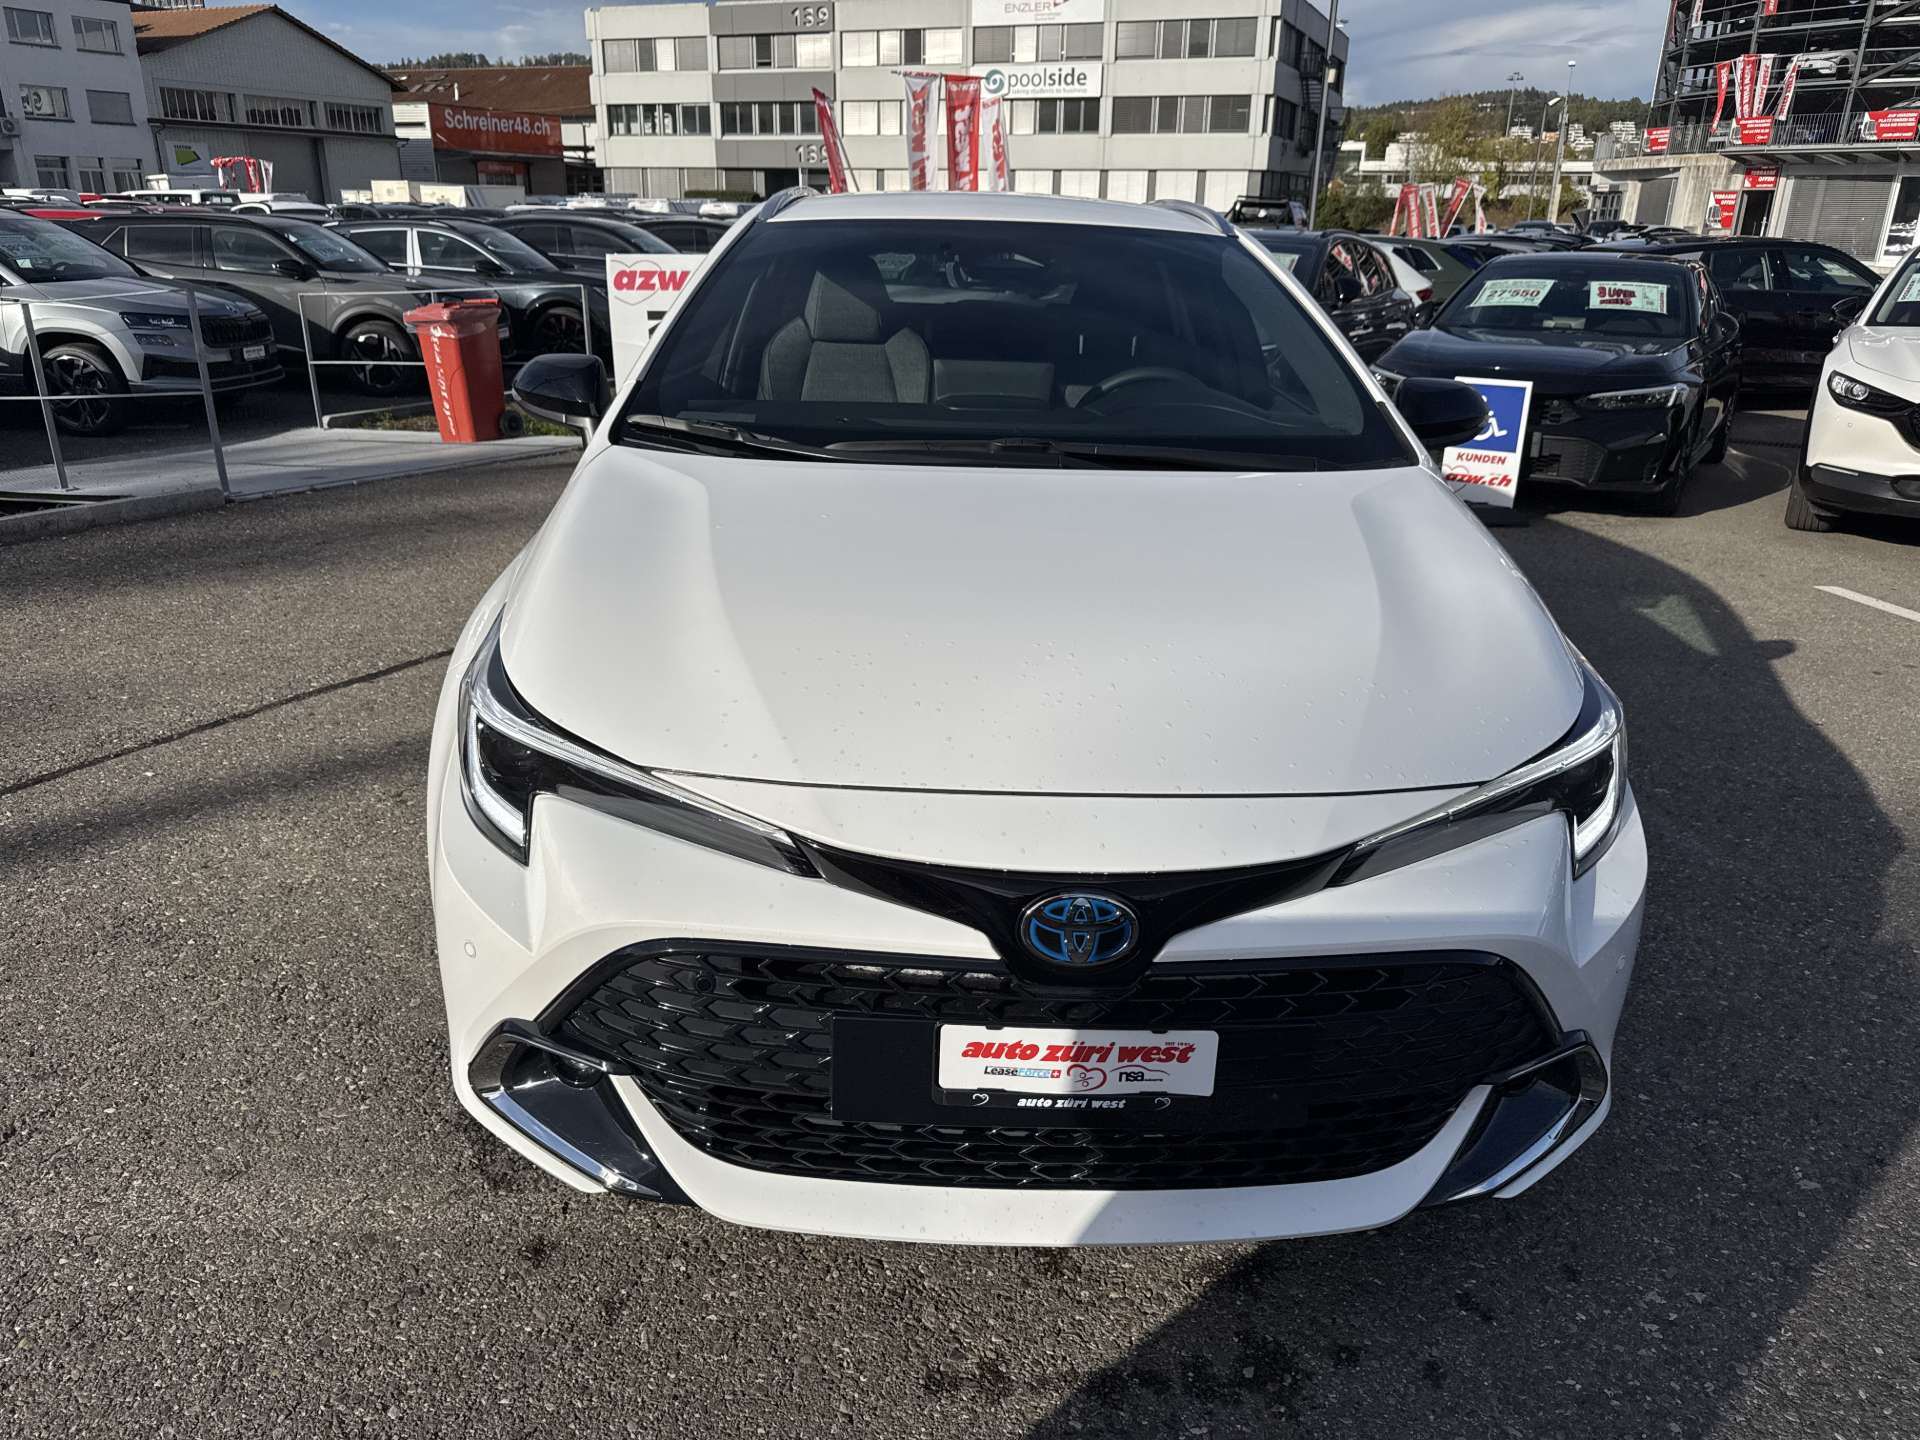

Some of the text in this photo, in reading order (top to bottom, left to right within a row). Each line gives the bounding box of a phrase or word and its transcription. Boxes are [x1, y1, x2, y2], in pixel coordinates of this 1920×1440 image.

[1004, 1, 1051, 13] ENZLER
[792, 6, 829, 27] 139
[1008, 67, 1088, 92] poolside
[444, 109, 551, 136] Schreiner48.ch
[1456, 452, 1508, 465] KUNDEN
[1445, 473, 1512, 487] azw.ch
[961, 1040, 1196, 1064] auto züri west
[984, 1066, 1050, 1078] LeaseForce
[1119, 1071, 1145, 1082] nsa
[1017, 1098, 1127, 1109] auto züri west
